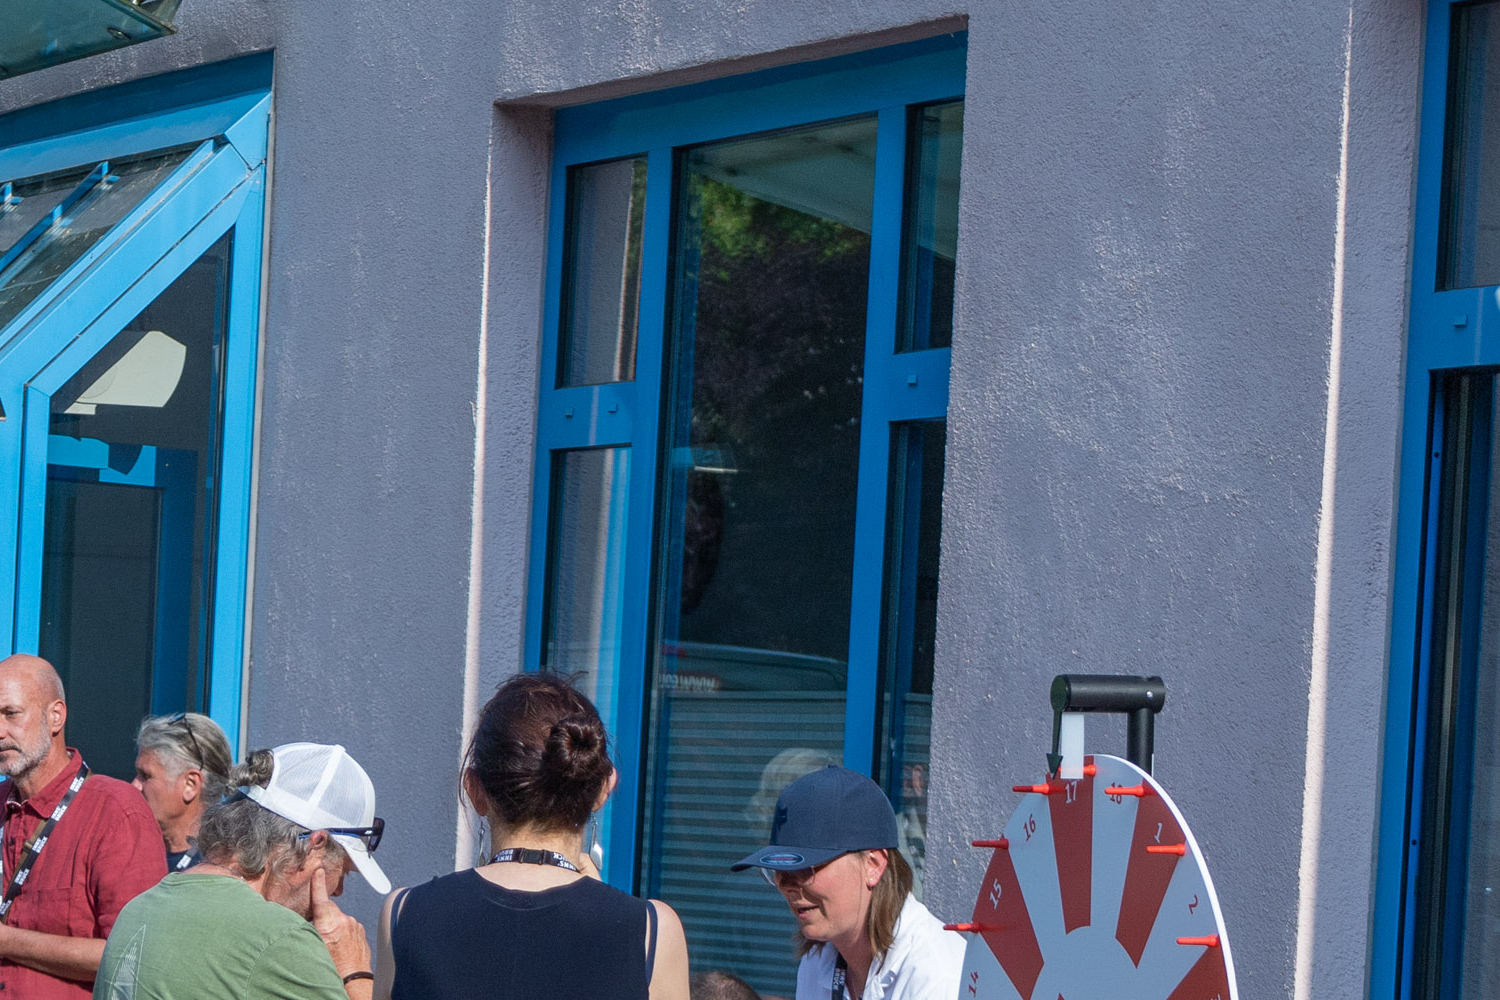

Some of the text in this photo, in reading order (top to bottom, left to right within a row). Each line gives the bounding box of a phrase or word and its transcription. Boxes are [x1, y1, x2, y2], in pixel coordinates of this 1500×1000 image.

[1064, 780, 1078, 804] 17
[1022, 813, 1037, 841] 16
[1154, 822, 1163, 844] 1
[989, 878, 1003, 910] 15
[1188, 894, 1200, 915] 2
[967, 971, 979, 998] 14
